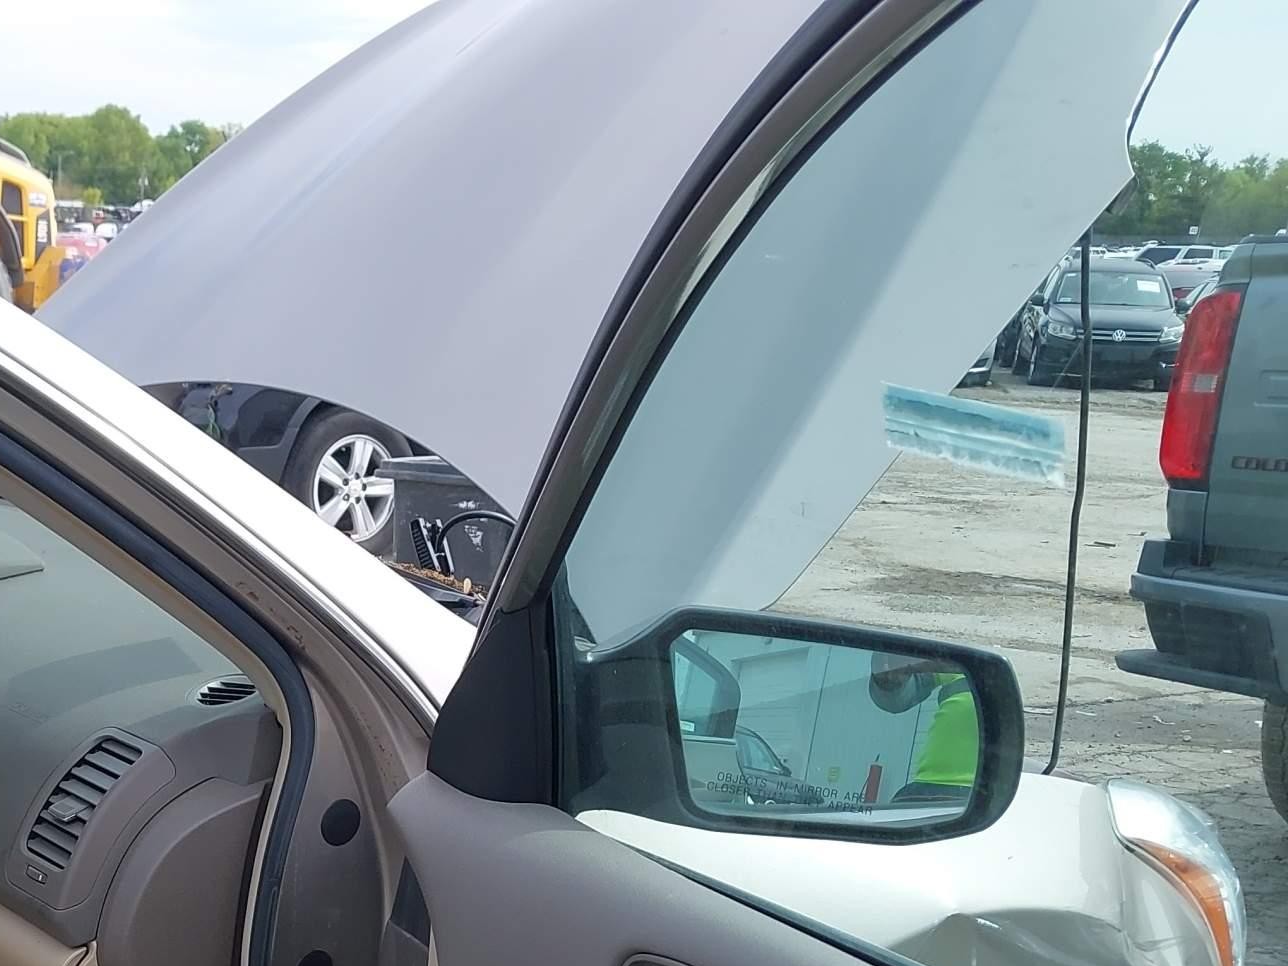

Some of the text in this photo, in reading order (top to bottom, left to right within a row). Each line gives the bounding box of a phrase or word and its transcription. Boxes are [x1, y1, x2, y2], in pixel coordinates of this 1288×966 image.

[707, 781, 750, 797] CLOSER
[717, 771, 768, 788] OBJECTS
[776, 780, 788, 791] IN
[793, 783, 838, 799] MIRROR
